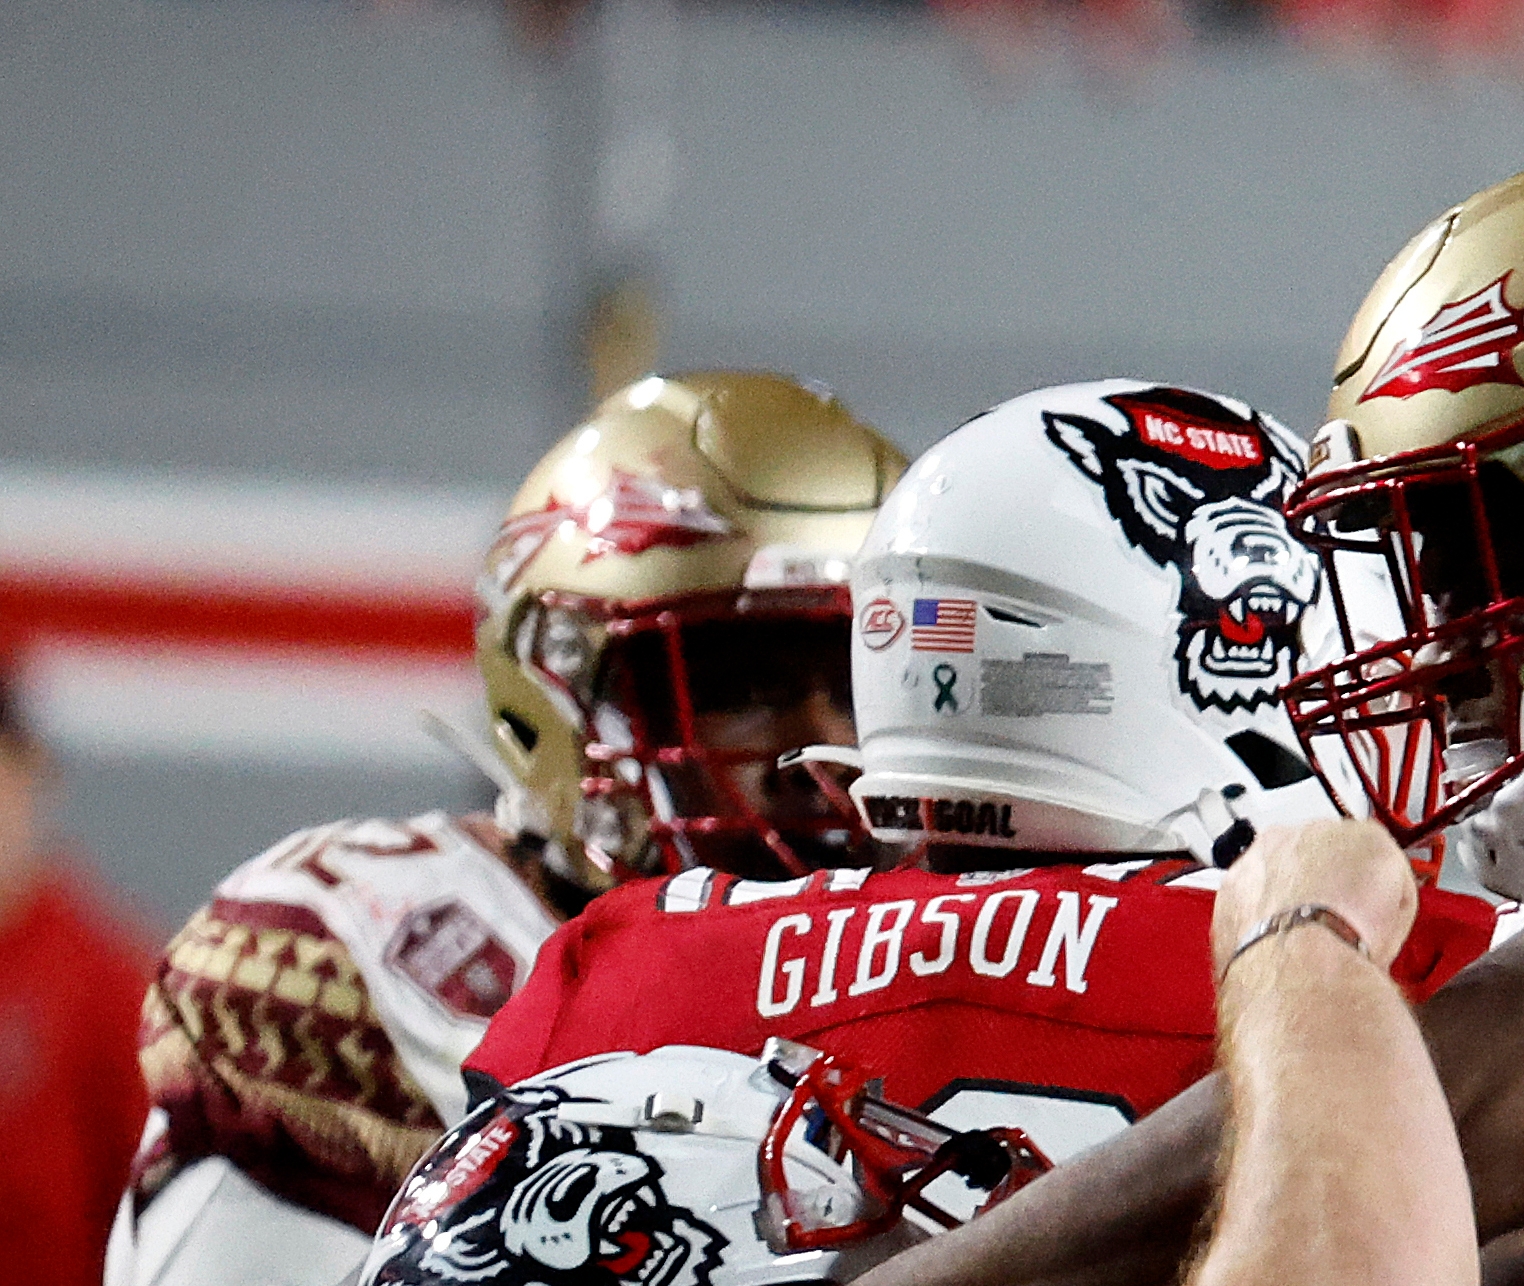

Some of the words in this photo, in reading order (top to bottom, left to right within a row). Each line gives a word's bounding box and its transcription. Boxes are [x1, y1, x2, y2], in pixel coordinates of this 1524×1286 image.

[1144, 414, 1184, 445] NC
[1185, 426, 1260, 460] STATE
[756, 888, 1119, 1021] GIBSON
[444, 1125, 514, 1187] STATE
